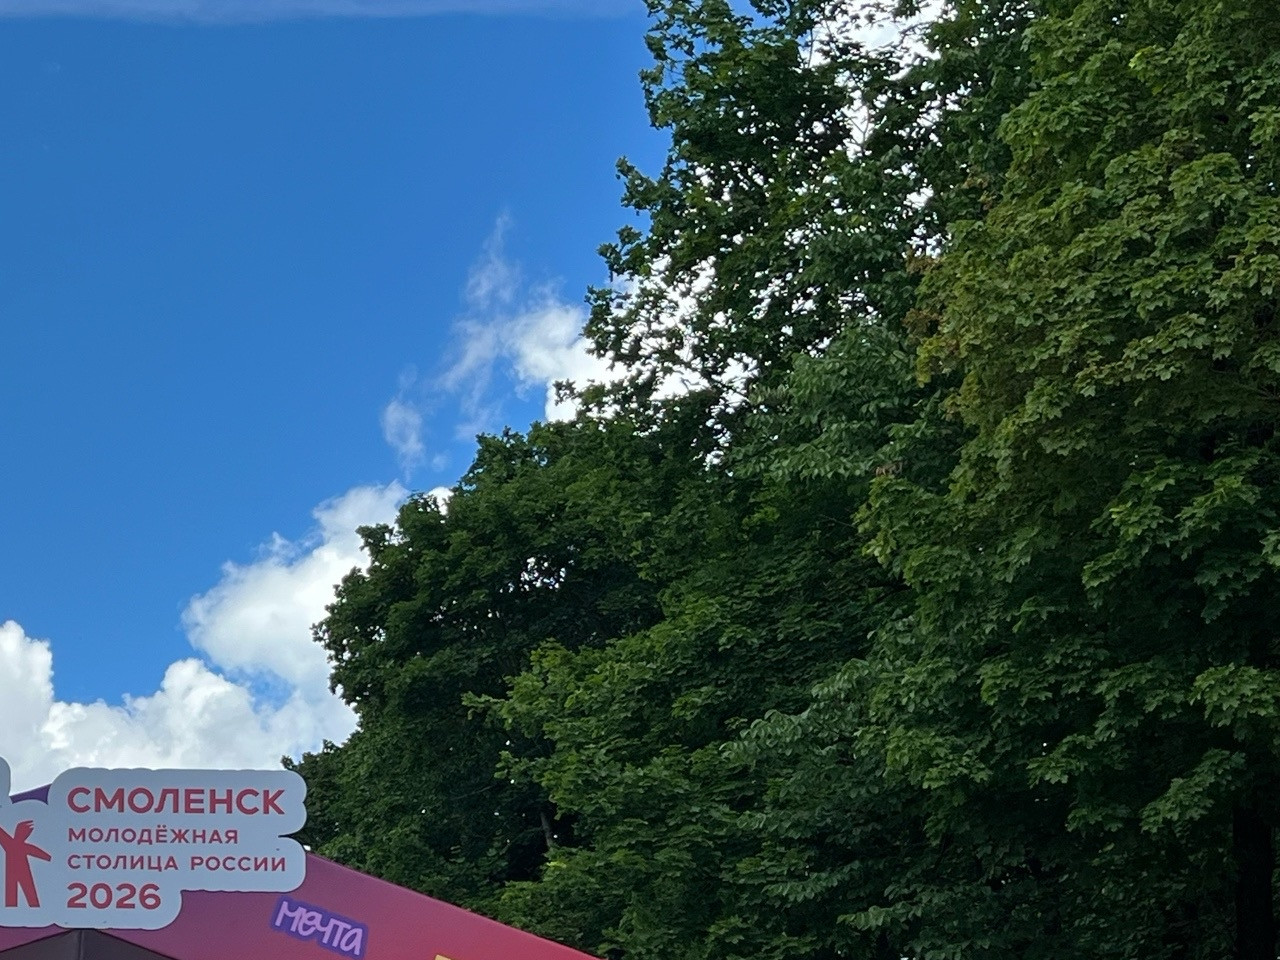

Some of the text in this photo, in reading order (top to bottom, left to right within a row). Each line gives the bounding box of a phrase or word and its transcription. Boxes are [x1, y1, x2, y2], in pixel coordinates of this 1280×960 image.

[66, 786, 285, 815] СМОЛЕНСК
[68, 824, 238, 845] МОЛОДЁЖНАЯ
[67, 854, 286, 872] СТОЛИЦА РОССИИ
[66, 883, 162, 910] 2026
